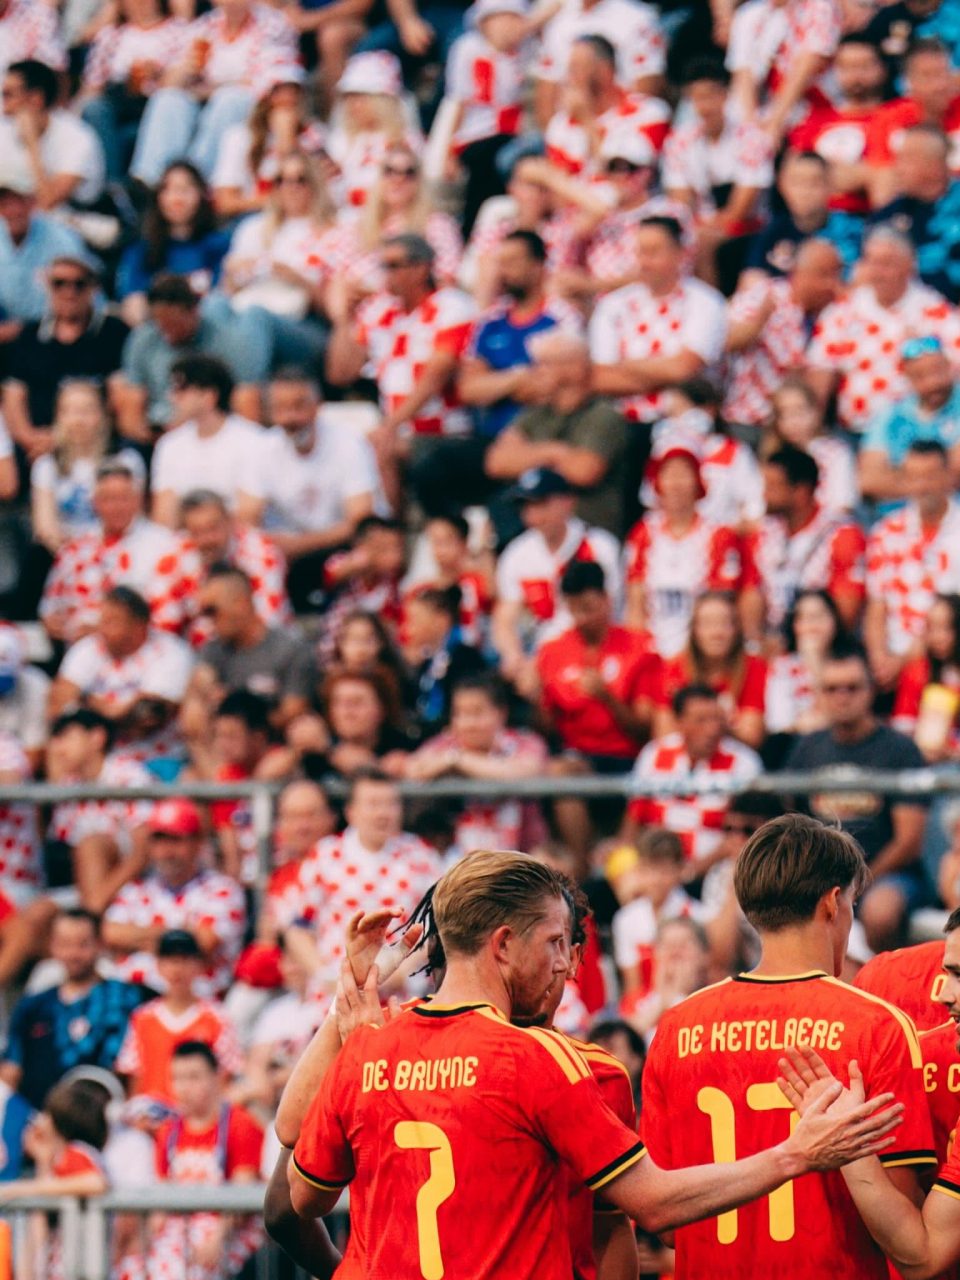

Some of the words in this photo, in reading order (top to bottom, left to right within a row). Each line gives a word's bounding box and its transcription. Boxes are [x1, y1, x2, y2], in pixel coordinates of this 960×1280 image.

[677, 1024, 705, 1059] DE
[710, 1017, 846, 1053] KETELAERE
[361, 1059, 390, 1093] DE
[393, 1056, 479, 1091] BRUYNE
[697, 1082, 802, 1245] 17
